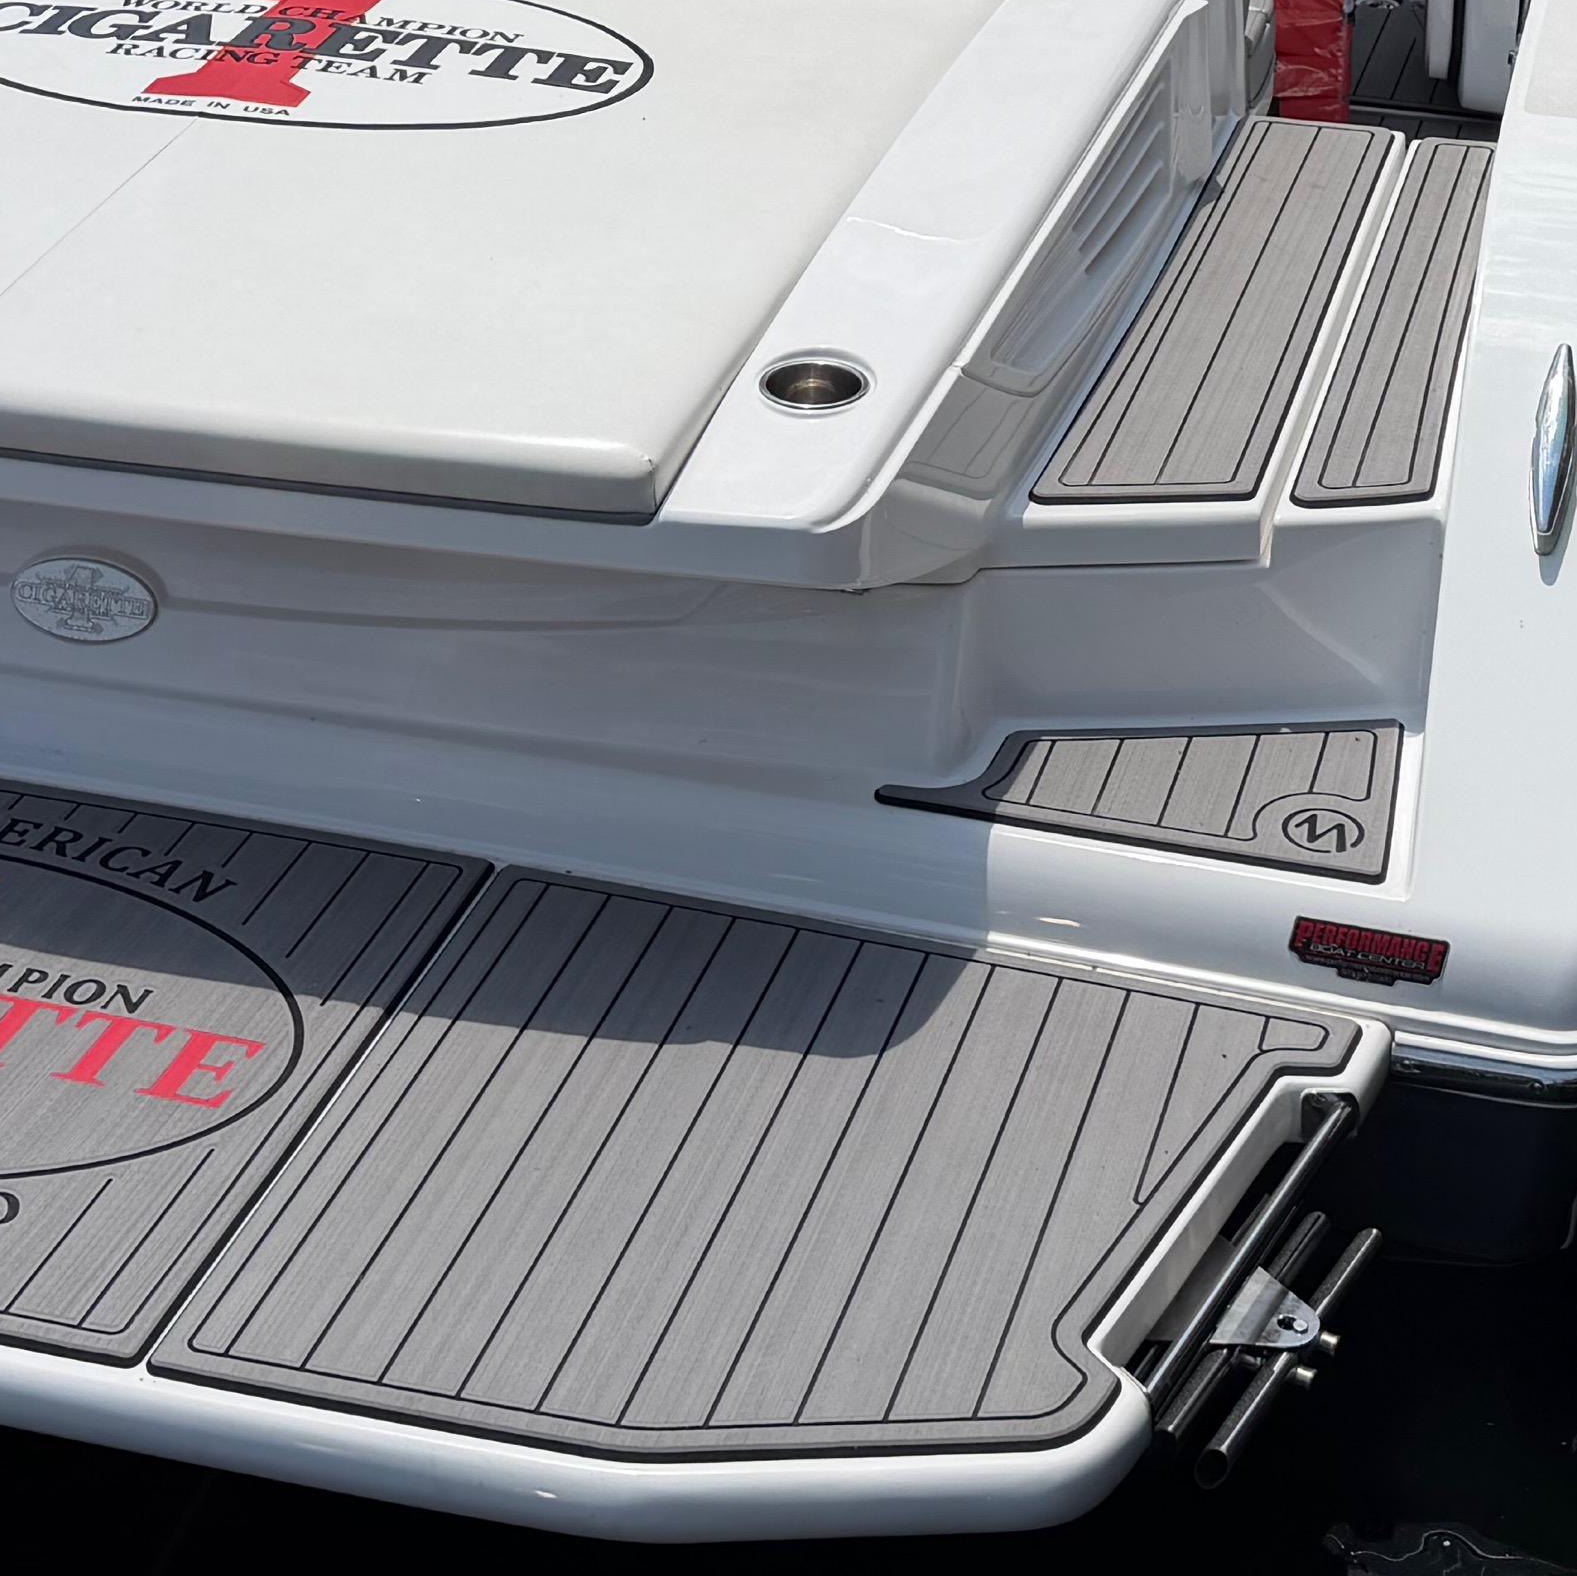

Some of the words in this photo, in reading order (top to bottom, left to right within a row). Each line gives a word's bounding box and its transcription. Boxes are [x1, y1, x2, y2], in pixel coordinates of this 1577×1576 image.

[279, 6, 524, 43] CHAMPION
[106, 43, 280, 65] RACING
[292, 55, 432, 84] TEAM
[131, 96, 194, 107] MADE
[207, 100, 231, 110] IN
[242, 105, 291, 116] USA
[1294, 920, 1446, 972] PERFORMANCE
